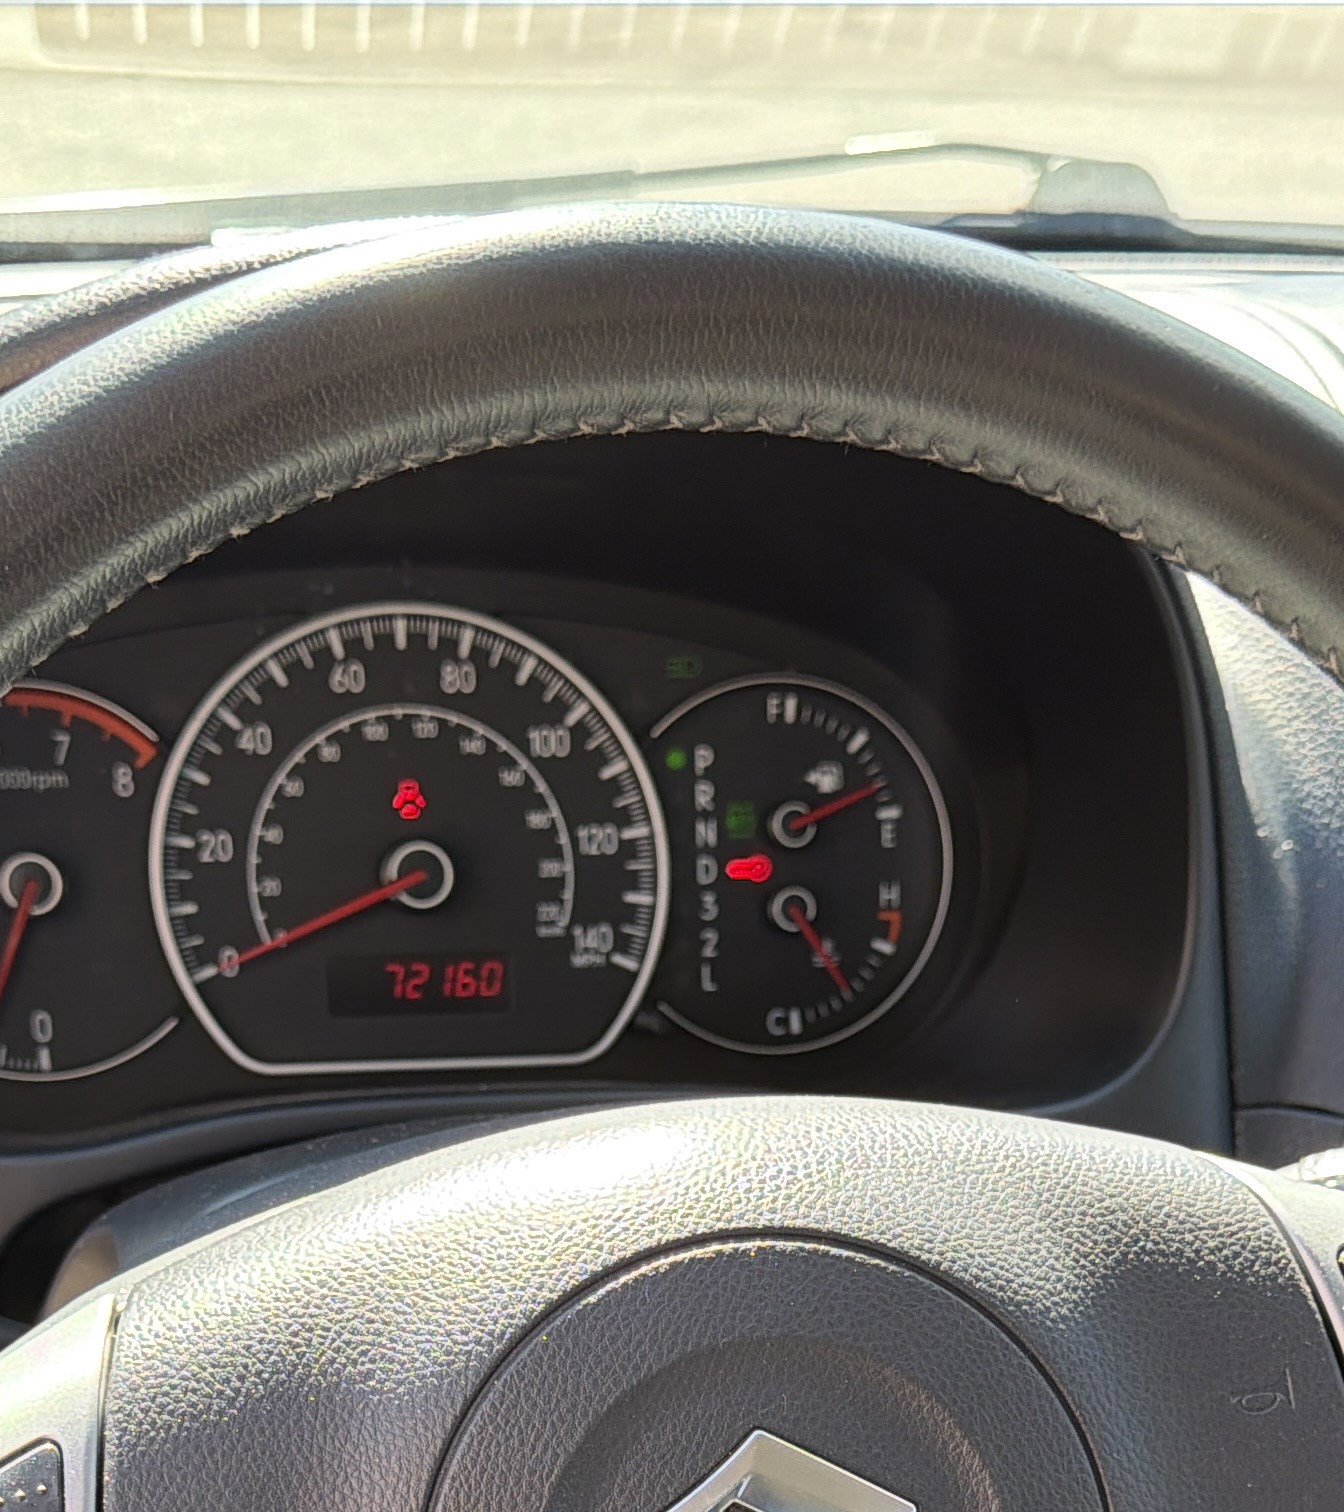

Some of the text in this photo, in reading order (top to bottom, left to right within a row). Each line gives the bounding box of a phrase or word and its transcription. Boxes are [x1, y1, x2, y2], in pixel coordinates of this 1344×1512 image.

[329, 660, 366, 694] 60
[440, 659, 477, 694] 80
[51, 728, 70, 766] 7
[236, 722, 273, 756] 40
[526, 724, 571, 758] 100
[111, 762, 135, 798] 8
[197, 829, 234, 863] 20
[577, 823, 619, 856] 120
[693, 744, 719, 992] P R N D 3 2 L
[572, 923, 614, 953] 140
[218, 946, 239, 978] 0
[385, 961, 505, 1000] 72160
[30, 1009, 53, 1043] 0
